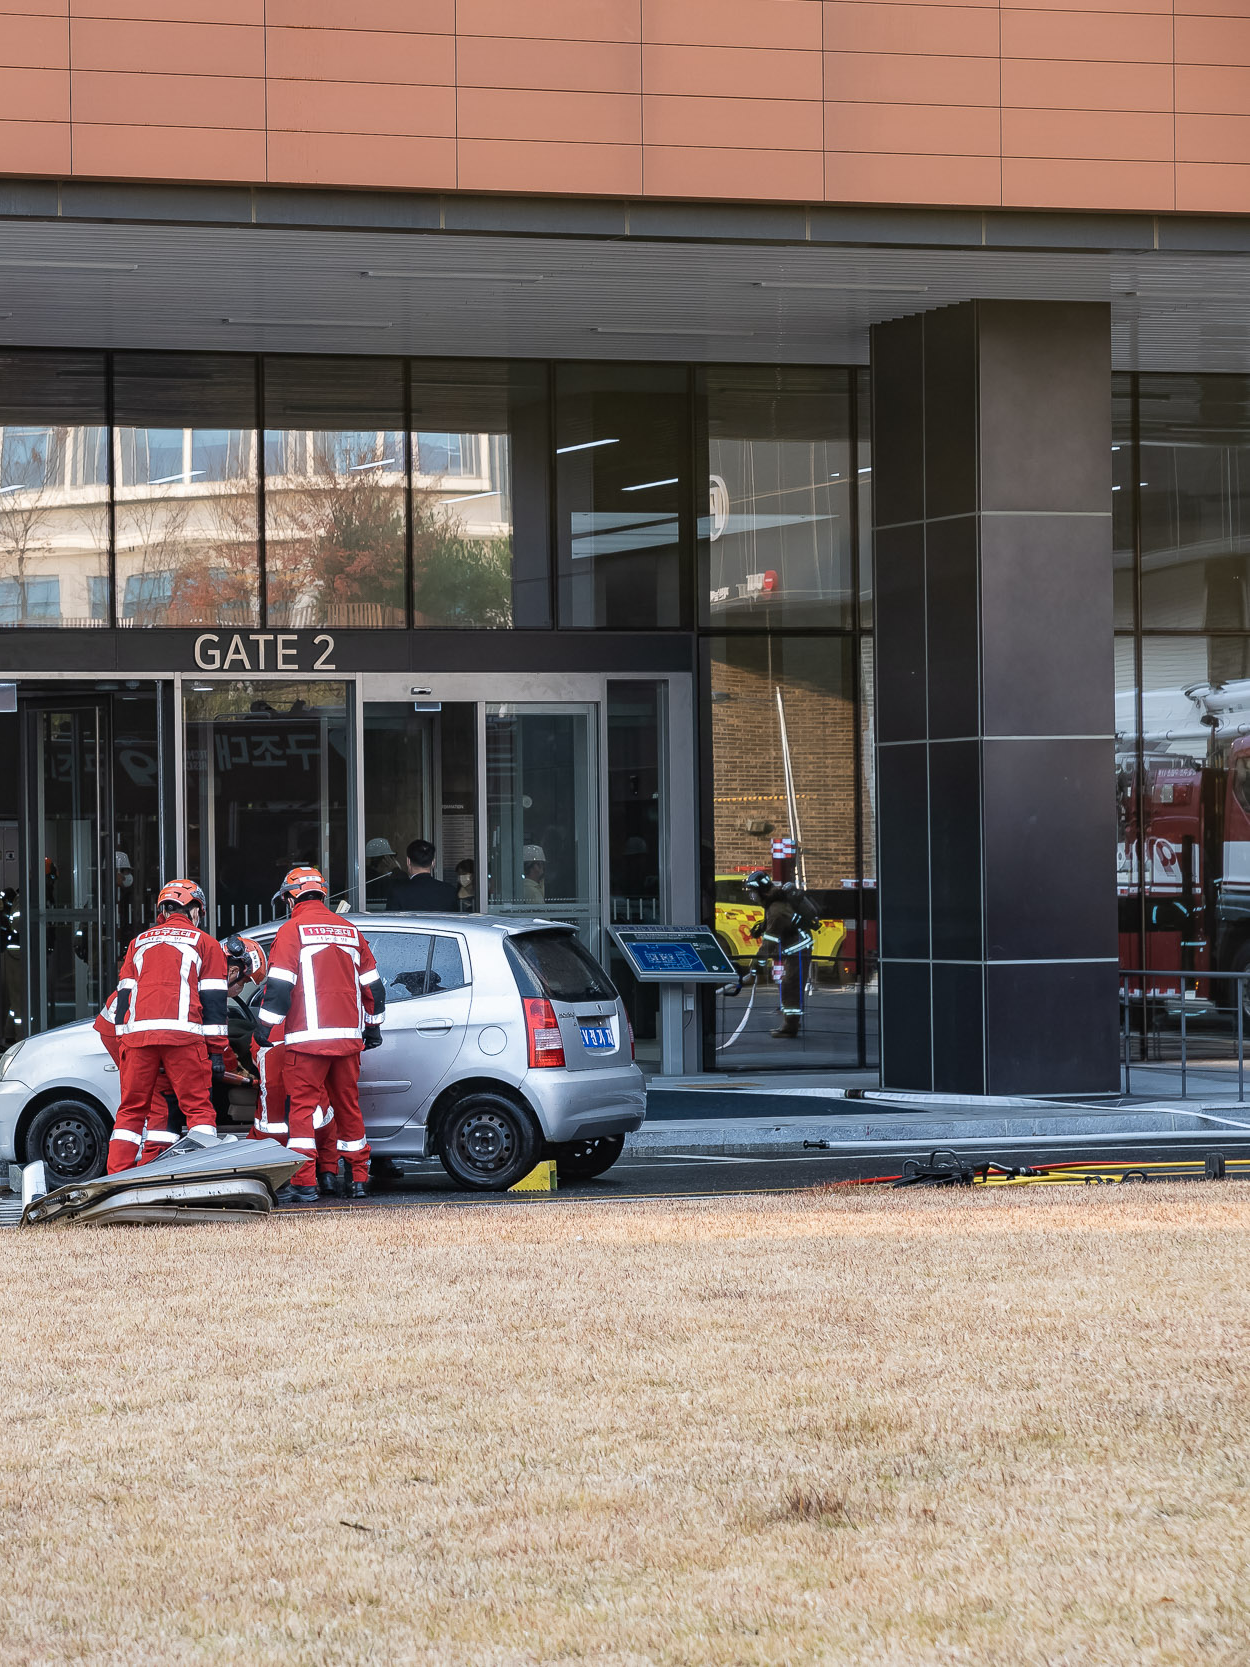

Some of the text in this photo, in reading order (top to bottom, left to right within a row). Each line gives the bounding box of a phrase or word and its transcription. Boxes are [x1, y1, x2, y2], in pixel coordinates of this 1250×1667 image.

[194, 633, 336, 670] GATE 2
[308, 927, 352, 937] 119구조대
